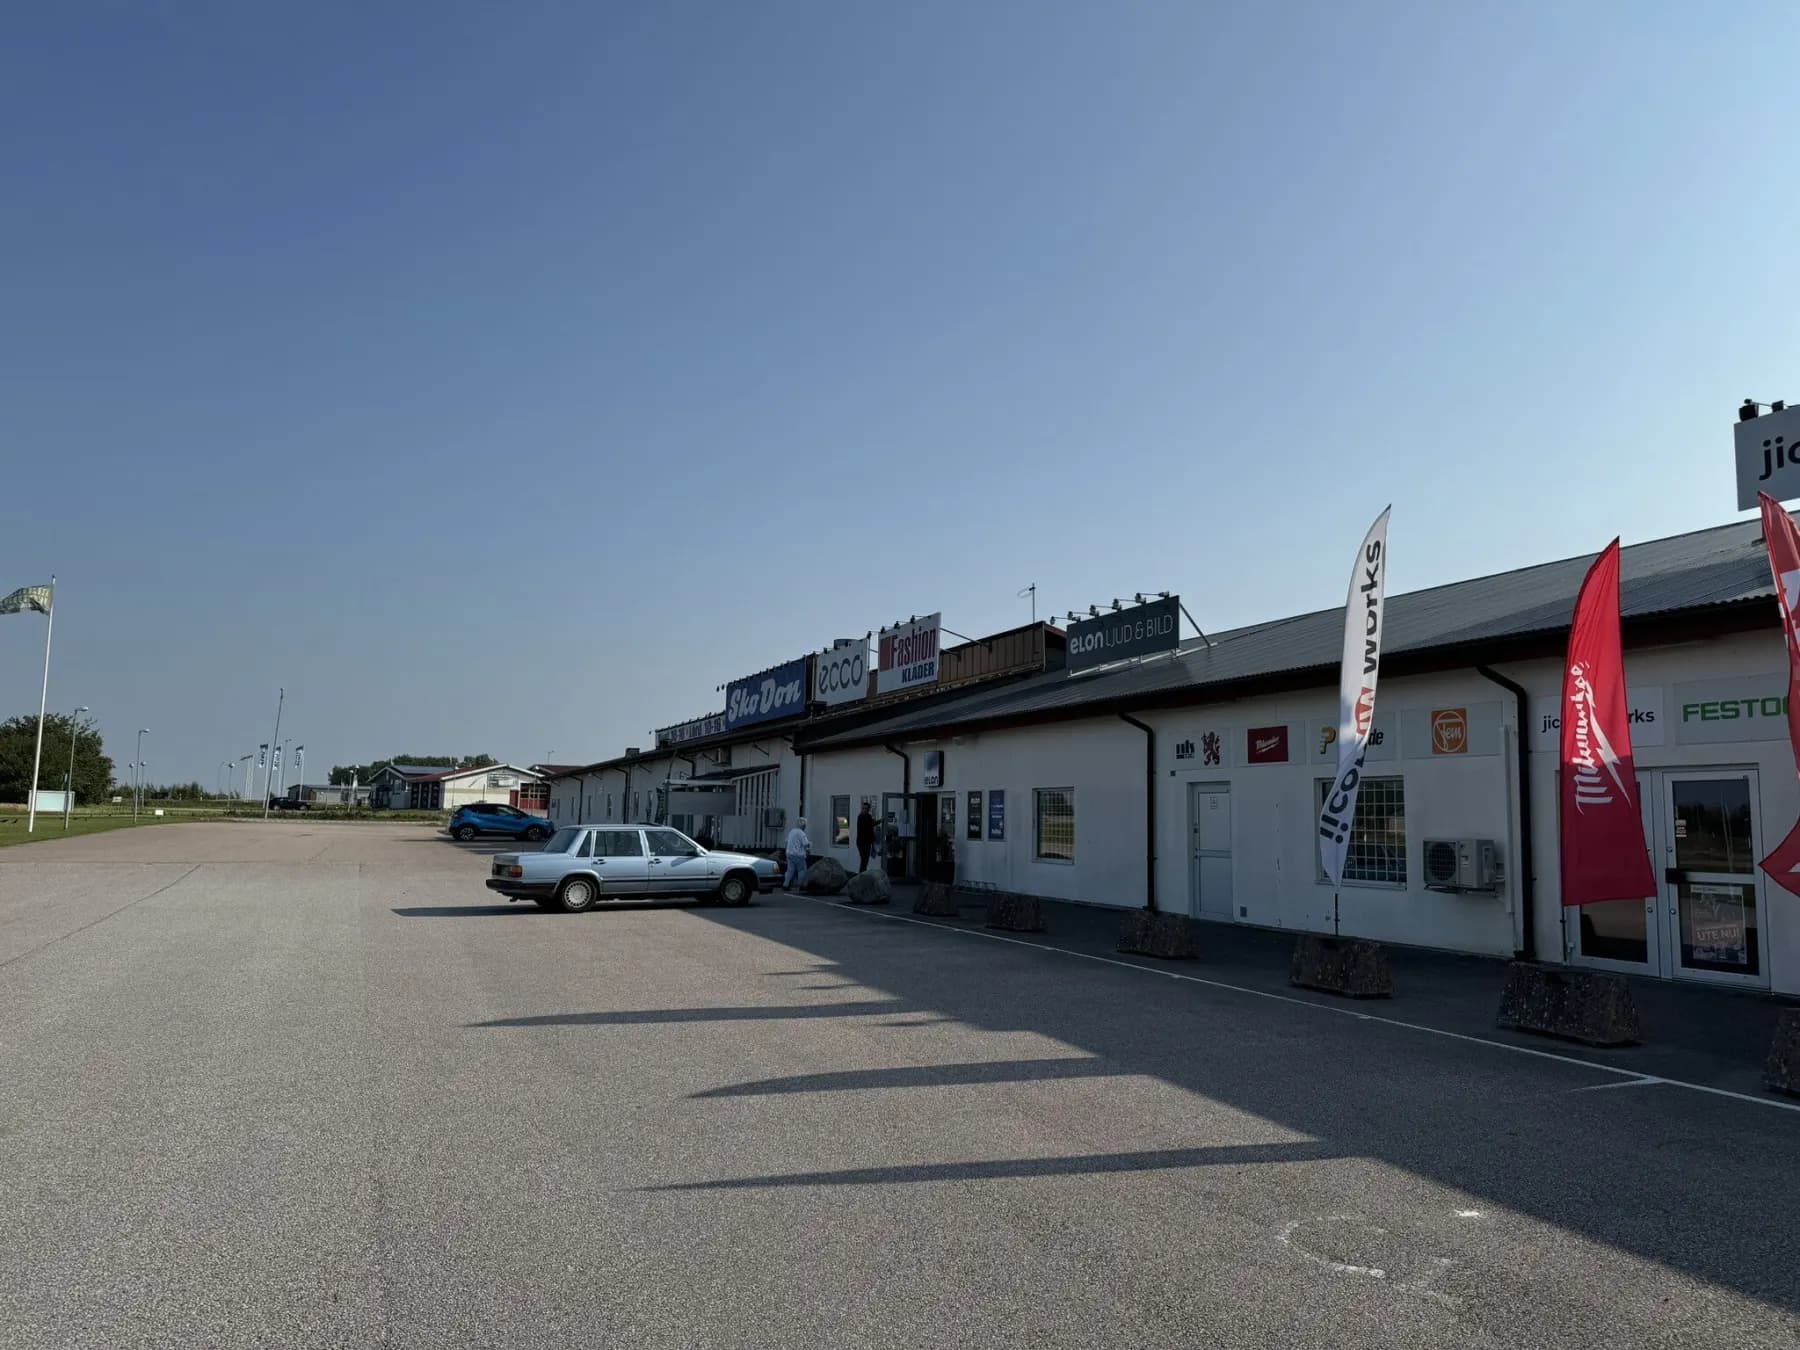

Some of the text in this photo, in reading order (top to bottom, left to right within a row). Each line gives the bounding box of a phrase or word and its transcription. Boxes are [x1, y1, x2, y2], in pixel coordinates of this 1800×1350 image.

[1360, 540, 1382, 675] works
[1105, 624, 1133, 648] LJUD
[1135, 621, 1144, 640] &
[1146, 614, 1173, 637] BILD
[890, 626, 937, 669] Fashion
[902, 660, 935, 683] KLÄDER
[1542, 709, 1655, 733] jic rks
[1682, 697, 1788, 722] FESTO
